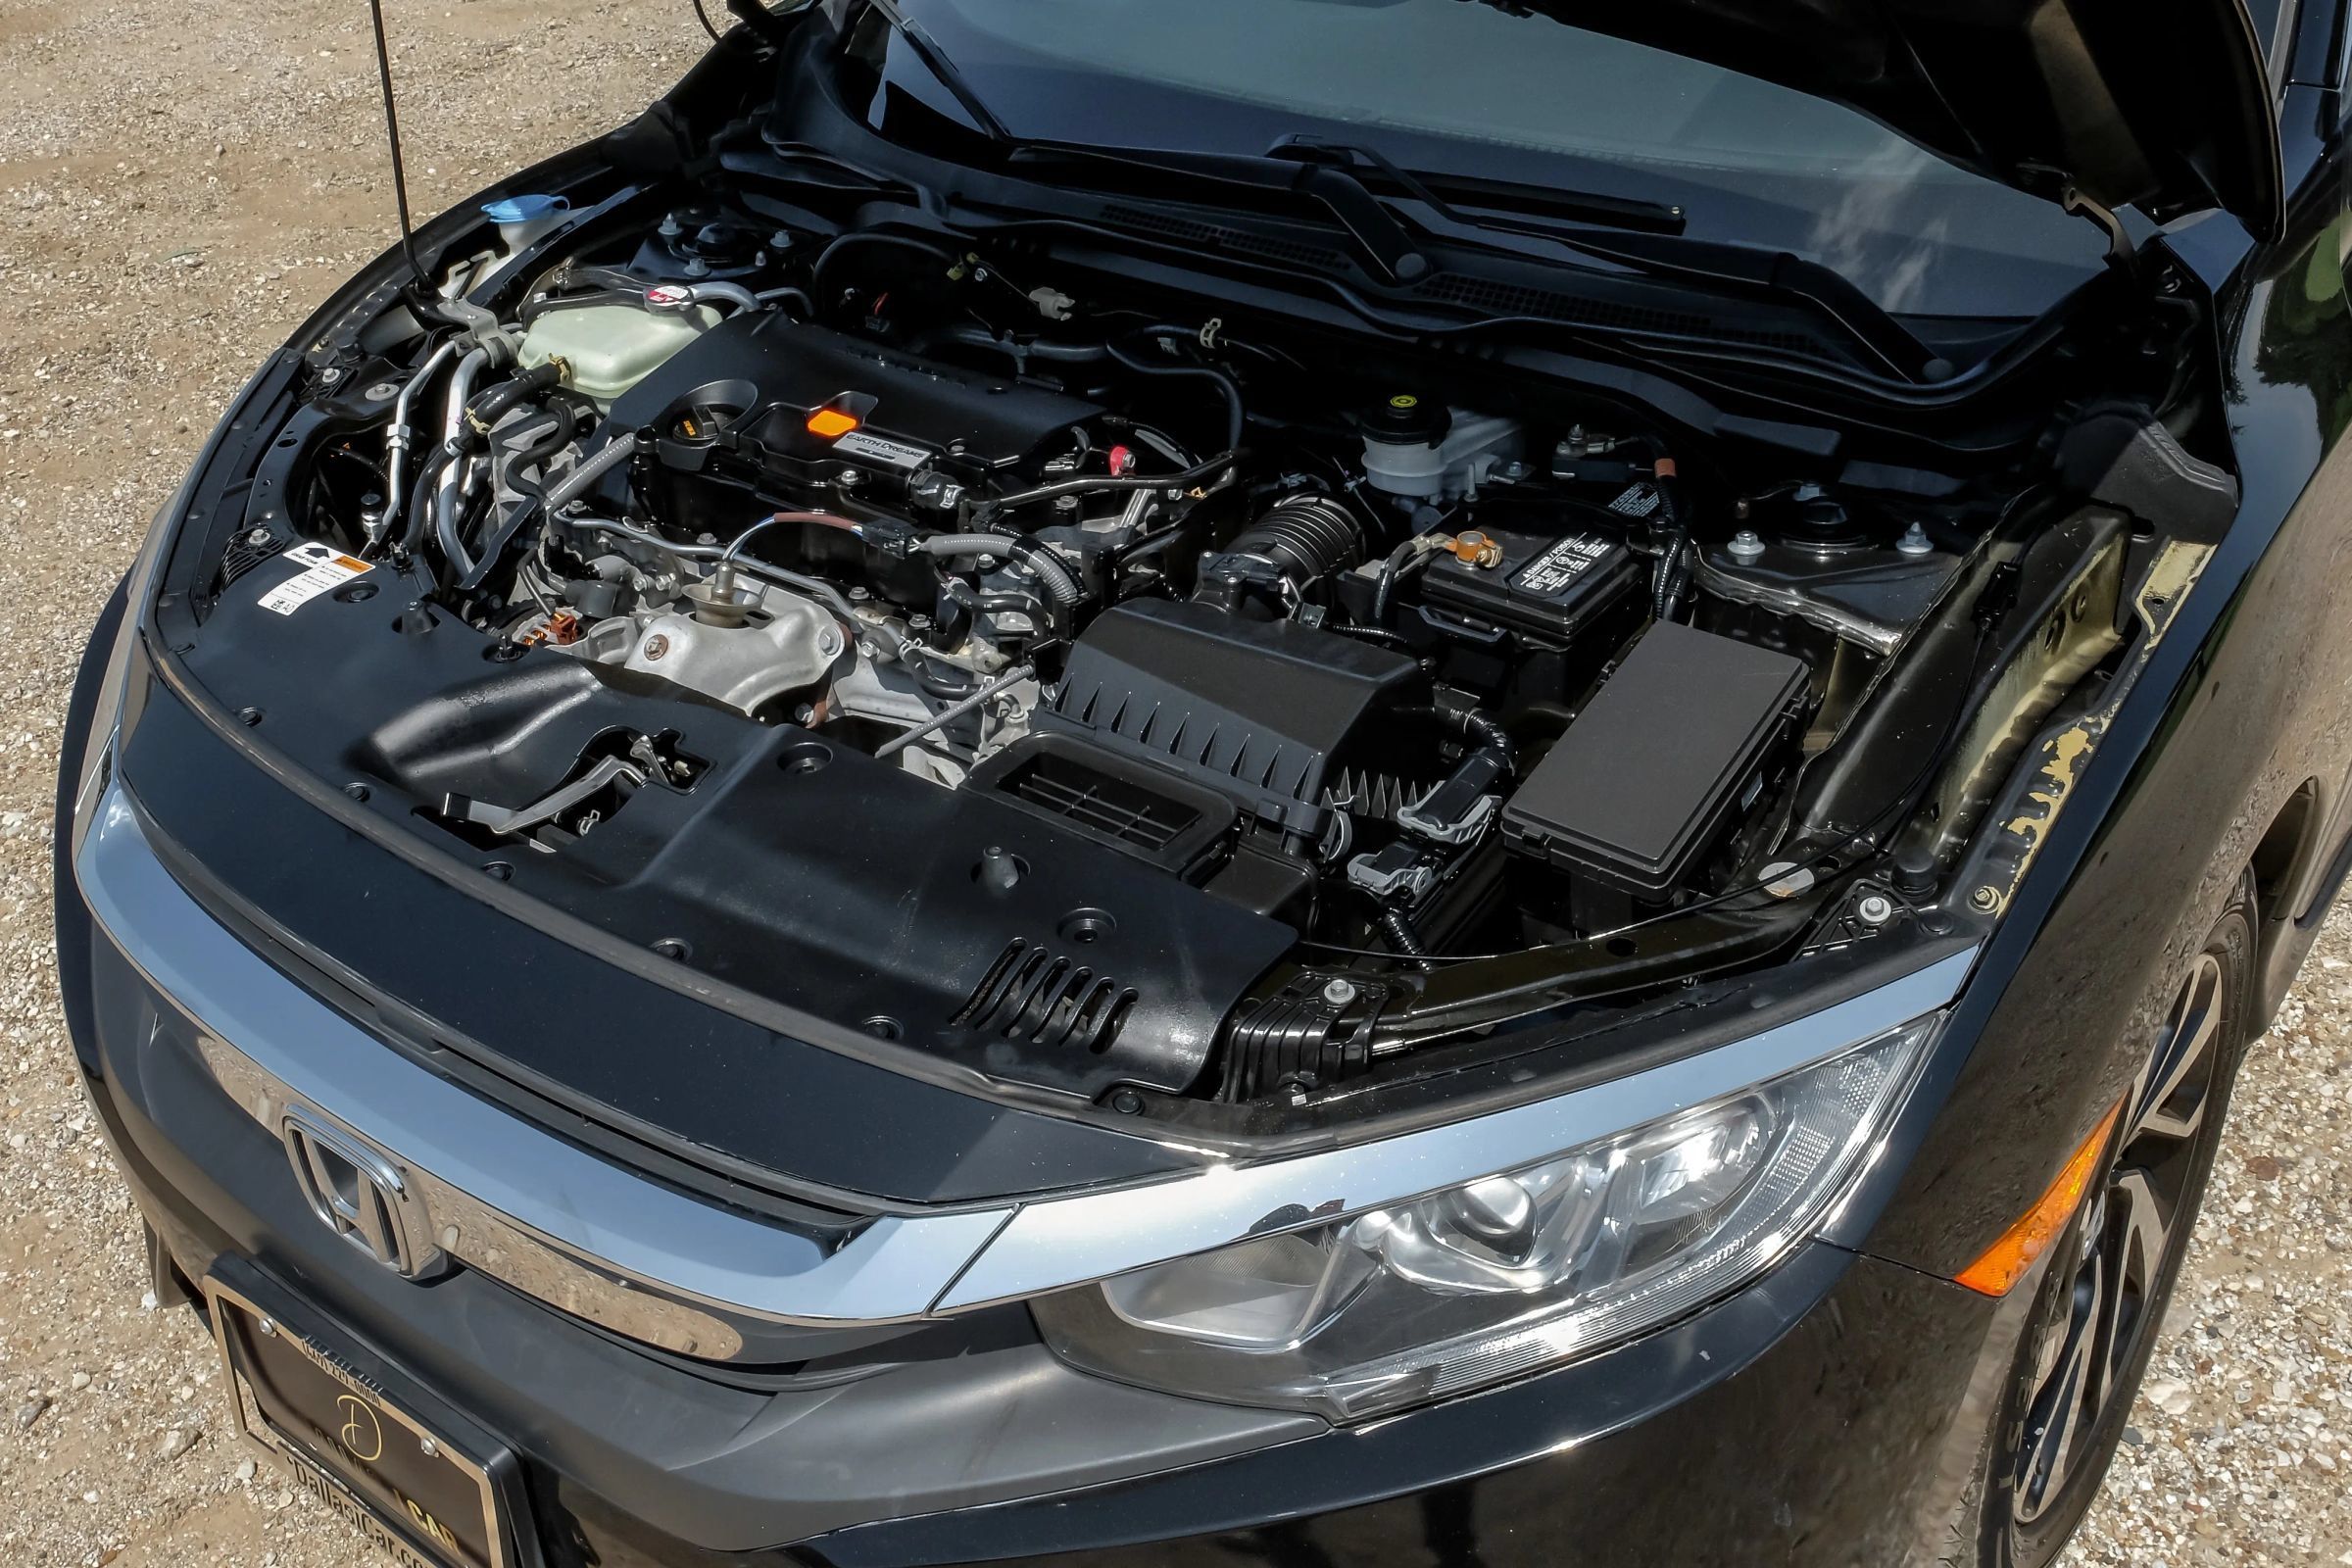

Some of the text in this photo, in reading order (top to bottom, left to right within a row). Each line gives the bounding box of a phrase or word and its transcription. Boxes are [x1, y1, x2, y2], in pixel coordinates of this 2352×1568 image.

[847, 434, 881, 446] EARTH
[882, 442, 924, 459] DREAMS
[294, 1458, 428, 1568] DallasiCar.co
